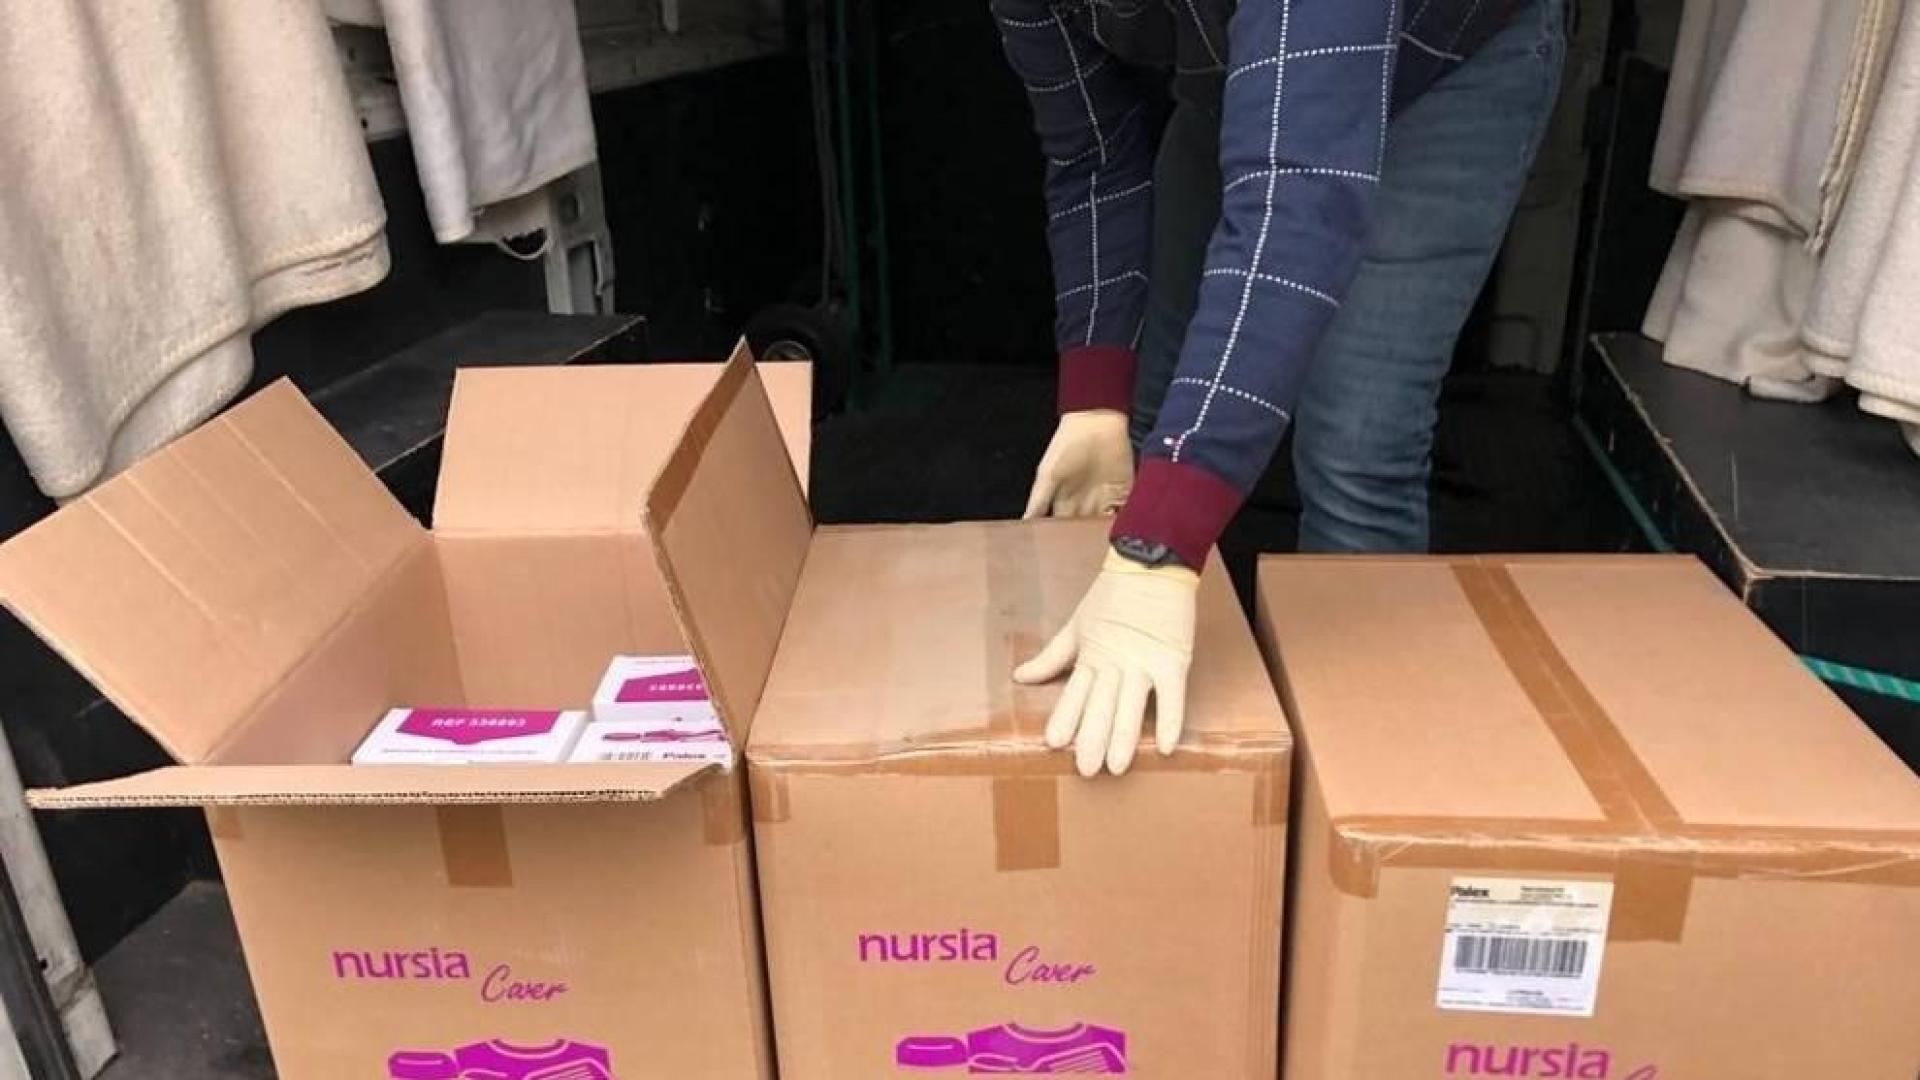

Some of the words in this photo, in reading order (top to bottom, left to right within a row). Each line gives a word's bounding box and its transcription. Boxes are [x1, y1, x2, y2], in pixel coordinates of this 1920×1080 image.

[857, 928, 998, 962] nursia
[332, 947, 471, 979] nursia
[1445, 1042, 1610, 1080] nursia
